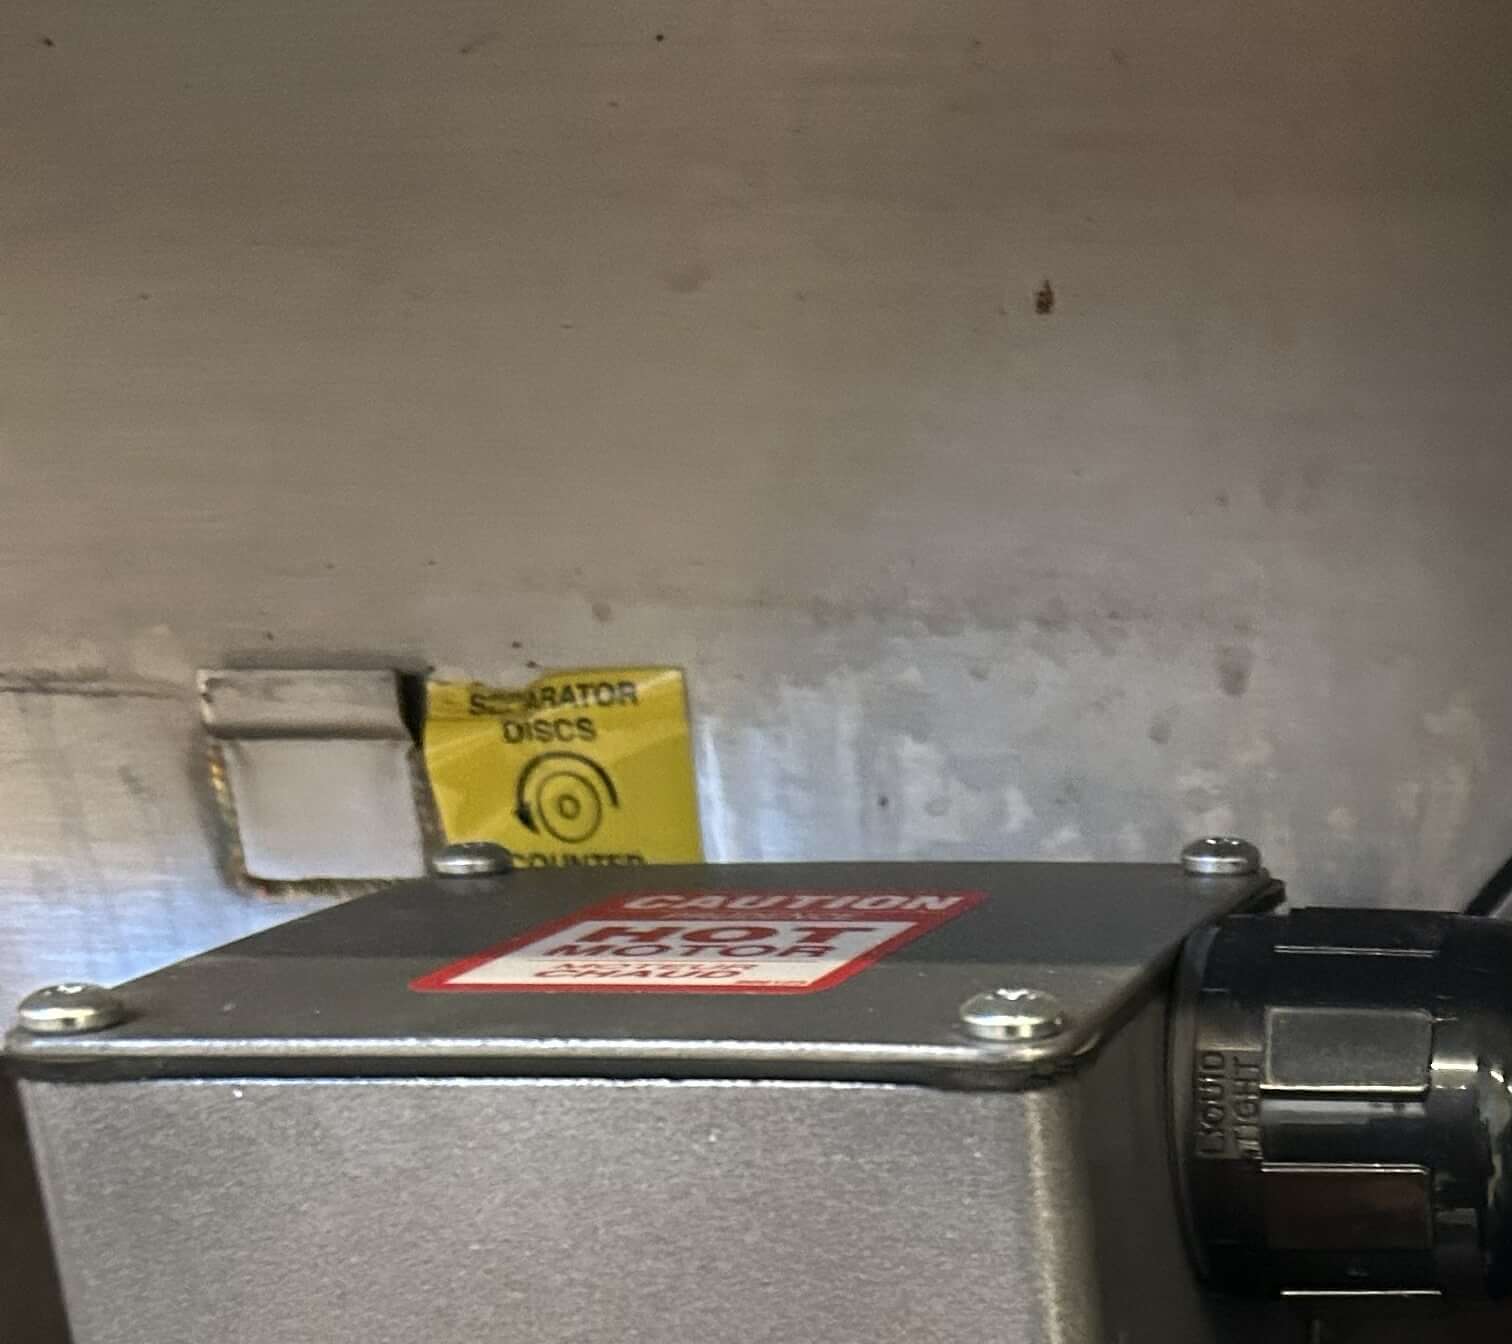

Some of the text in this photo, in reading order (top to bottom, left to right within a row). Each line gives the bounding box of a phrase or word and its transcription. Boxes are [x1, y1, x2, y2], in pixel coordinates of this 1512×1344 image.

[470, 680, 638, 716] SARATOR
[503, 717, 597, 744] DISCS
[622, 894, 964, 911] CAUTION
[575, 925, 877, 944] HOT
[542, 943, 838, 958] MOTOR
[534, 968, 742, 979] CHAUD
